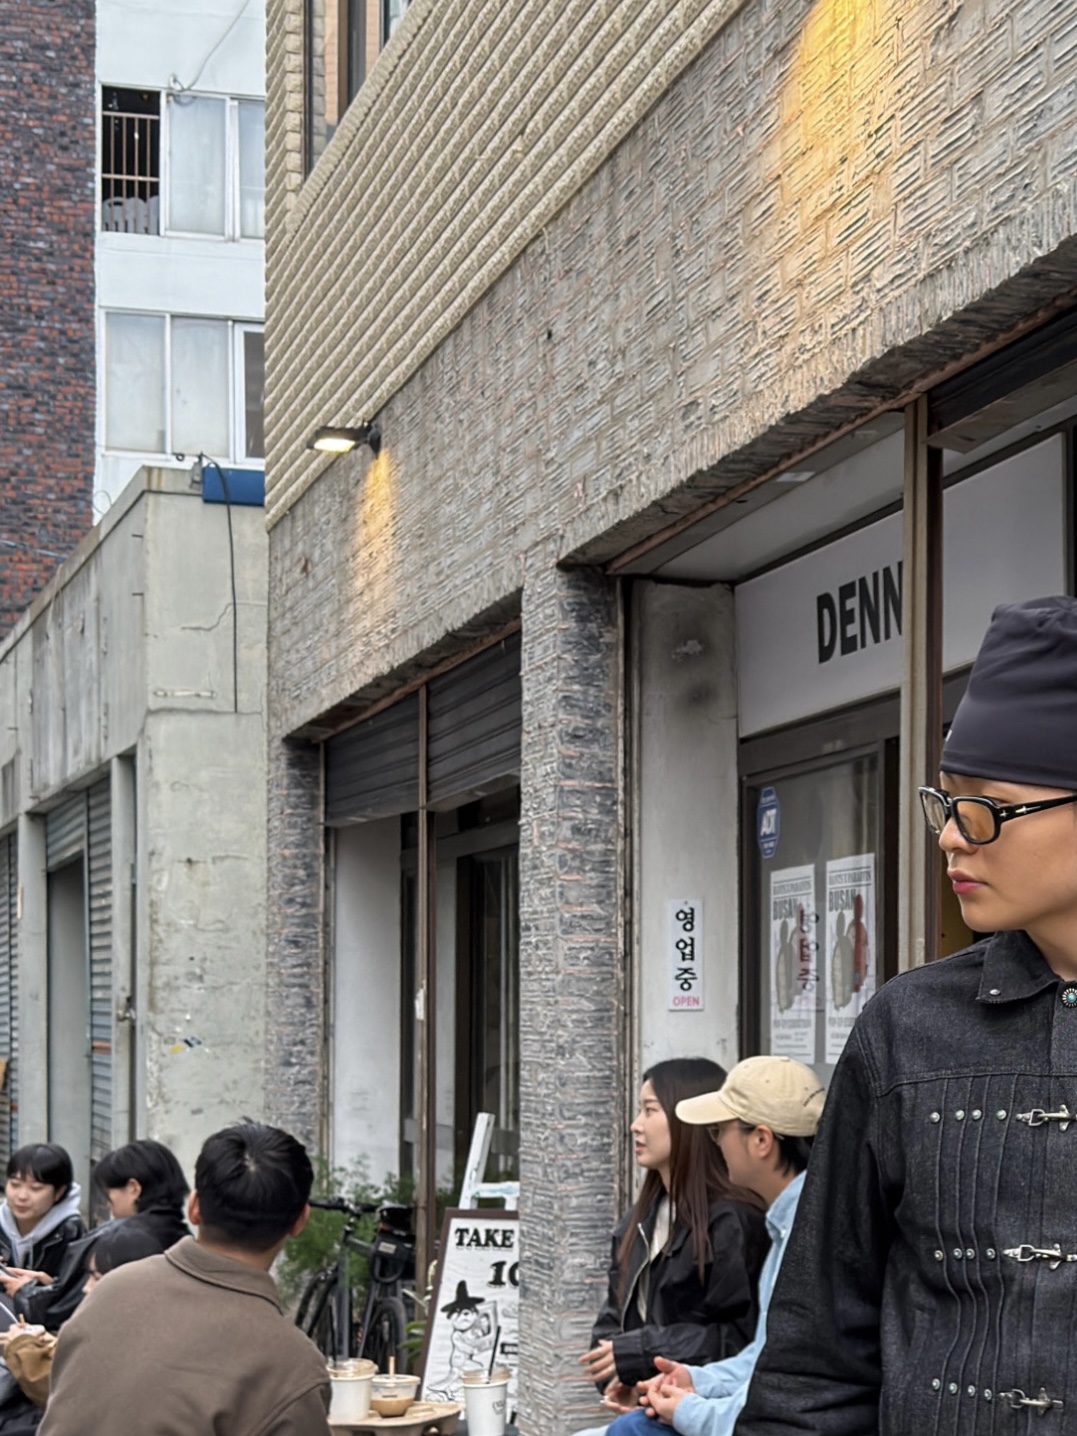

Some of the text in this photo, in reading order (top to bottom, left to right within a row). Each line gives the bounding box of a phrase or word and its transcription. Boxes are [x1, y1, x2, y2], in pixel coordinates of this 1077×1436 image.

[675, 907, 698, 992] 영업중
[672, 995, 701, 1007] OPEN
[455, 1227, 515, 1249] TAKE
